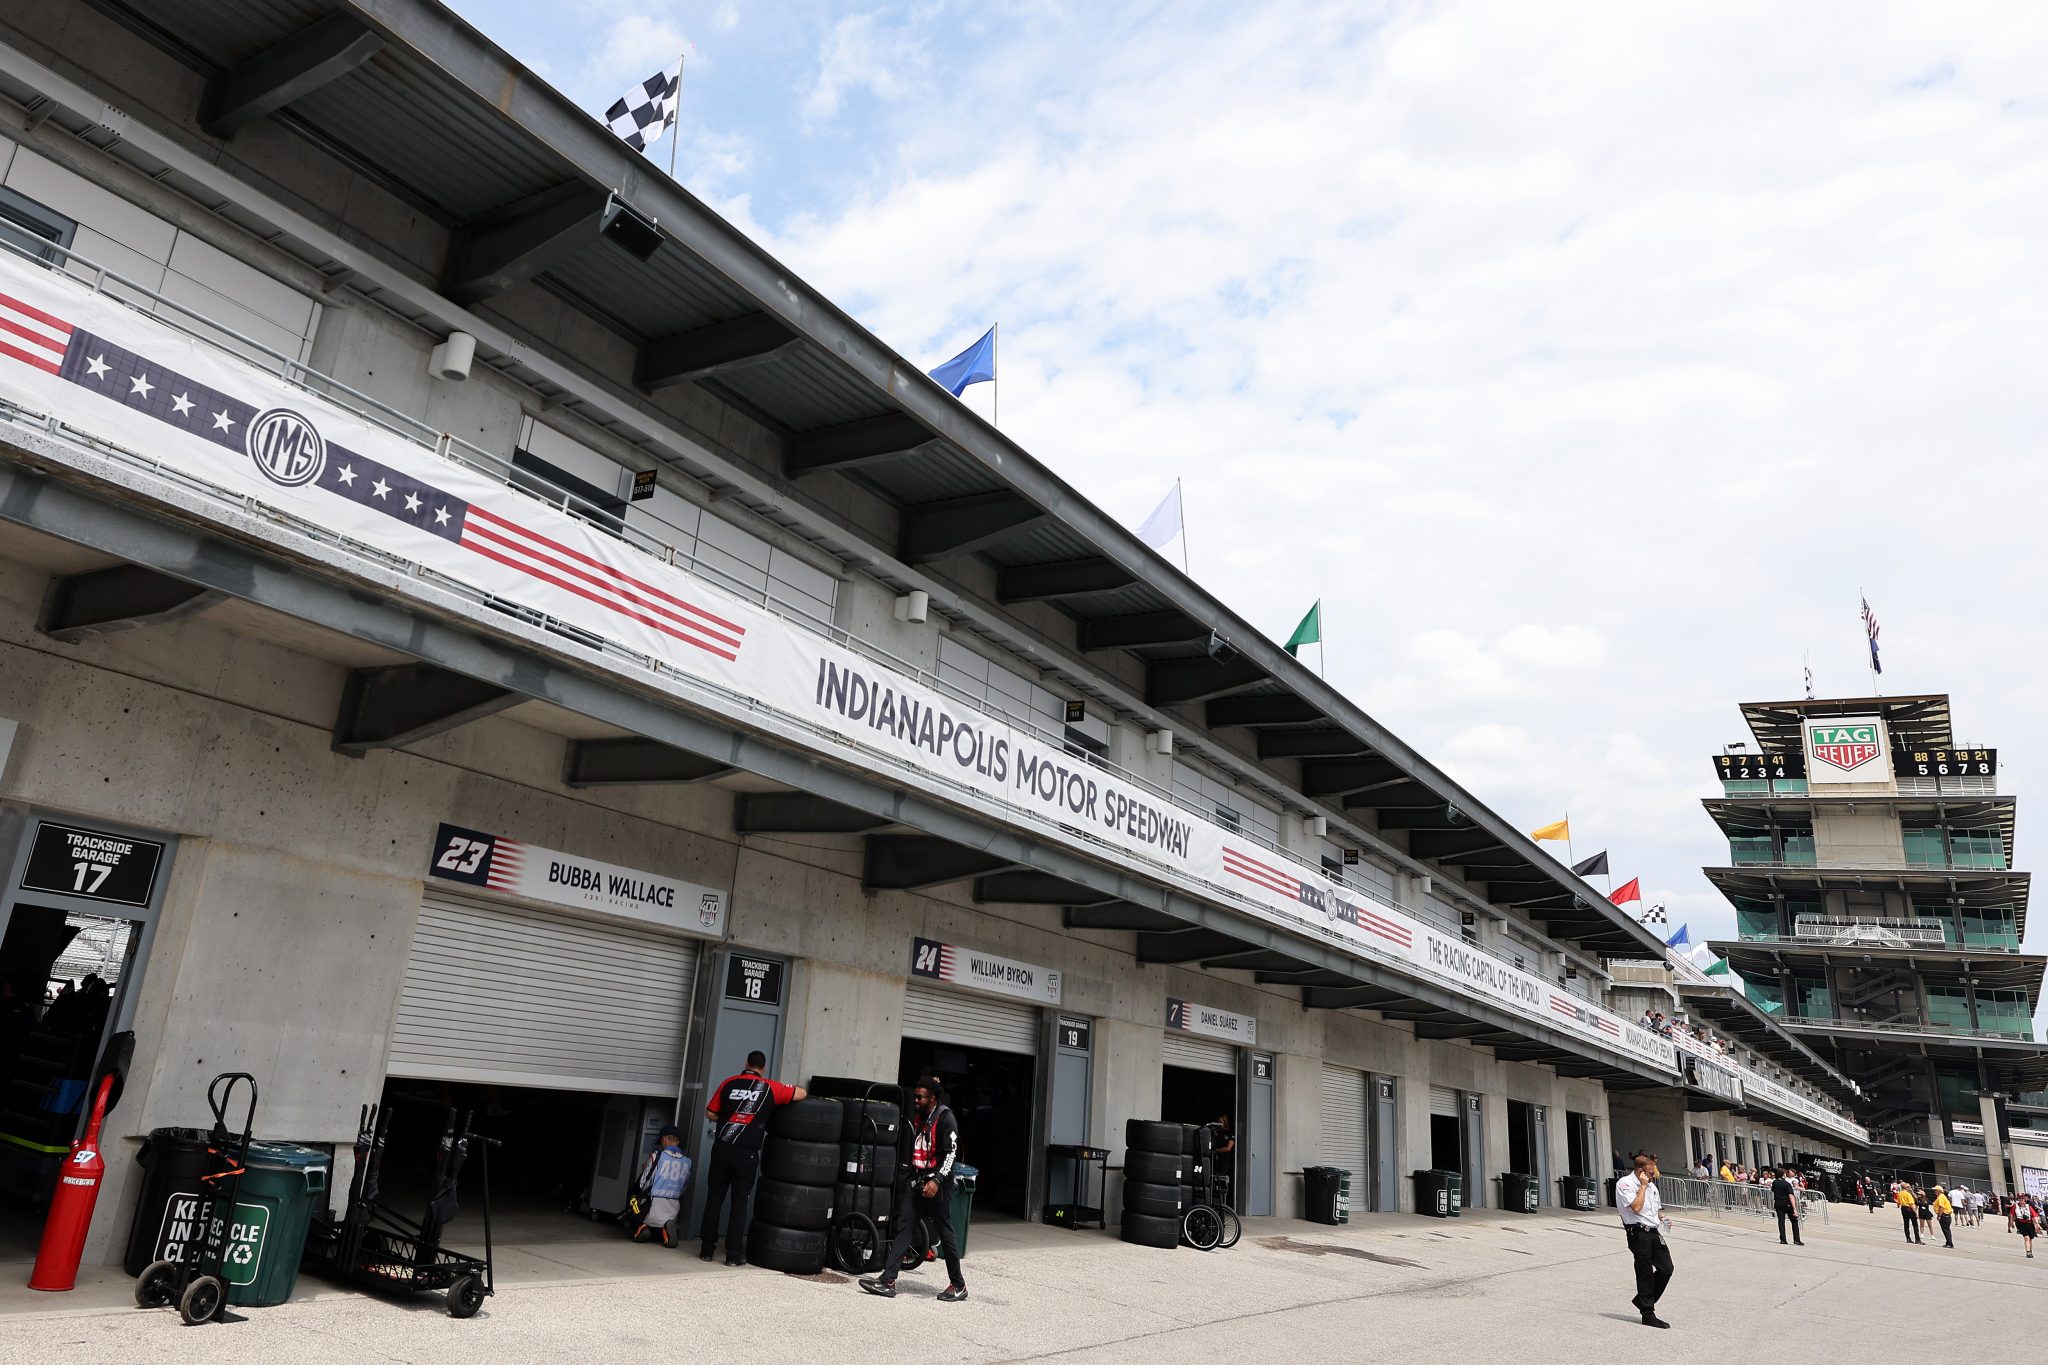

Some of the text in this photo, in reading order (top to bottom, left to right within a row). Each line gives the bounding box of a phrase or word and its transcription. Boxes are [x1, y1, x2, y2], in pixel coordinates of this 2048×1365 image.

[262, 418, 314, 477] IMS
[1816, 728, 1871, 743] TAG
[816, 657, 1191, 859] INDIANAPOLIS MOTOR SPEEDWAY
[1721, 755, 1784, 766] 9 7 1 41
[1816, 745, 1875, 767] HEUER
[1914, 751, 1988, 762] 88 2 19 21
[1723, 767, 1785, 779] 1 2 3 4
[1918, 763, 1990, 775] 5 6 7 8
[66, 833, 133, 855] TRACKSIDE
[72, 847, 121, 865] GARAGE
[437, 836, 489, 874] 23
[73, 861, 112, 893] 17
[548, 861, 675, 908] BUBBA WALLACE
[699, 901, 719, 914] 400
[741, 960, 770, 972] TRACKSIDE
[916, 944, 937, 972] 24
[744, 968, 766, 979] GARAGE
[970, 957, 1033, 986] WILLIAM BYRON
[1427, 936, 1540, 1005] THE RACING CAPITAL OF THE WORLD
[745, 977, 762, 999] 18
[1170, 1004, 1178, 1021] 7
[1201, 1011, 1219, 1027] DANIEL
[1219, 1015, 1238, 1031] SUÁREZ
[1068, 1030, 1078, 1046] 19
[1257, 1063, 1266, 1077] 20
[729, 1088, 764, 1101] 23XI
[73, 1150, 97, 1163] 97
[1193, 1165, 1203, 1174] 24
